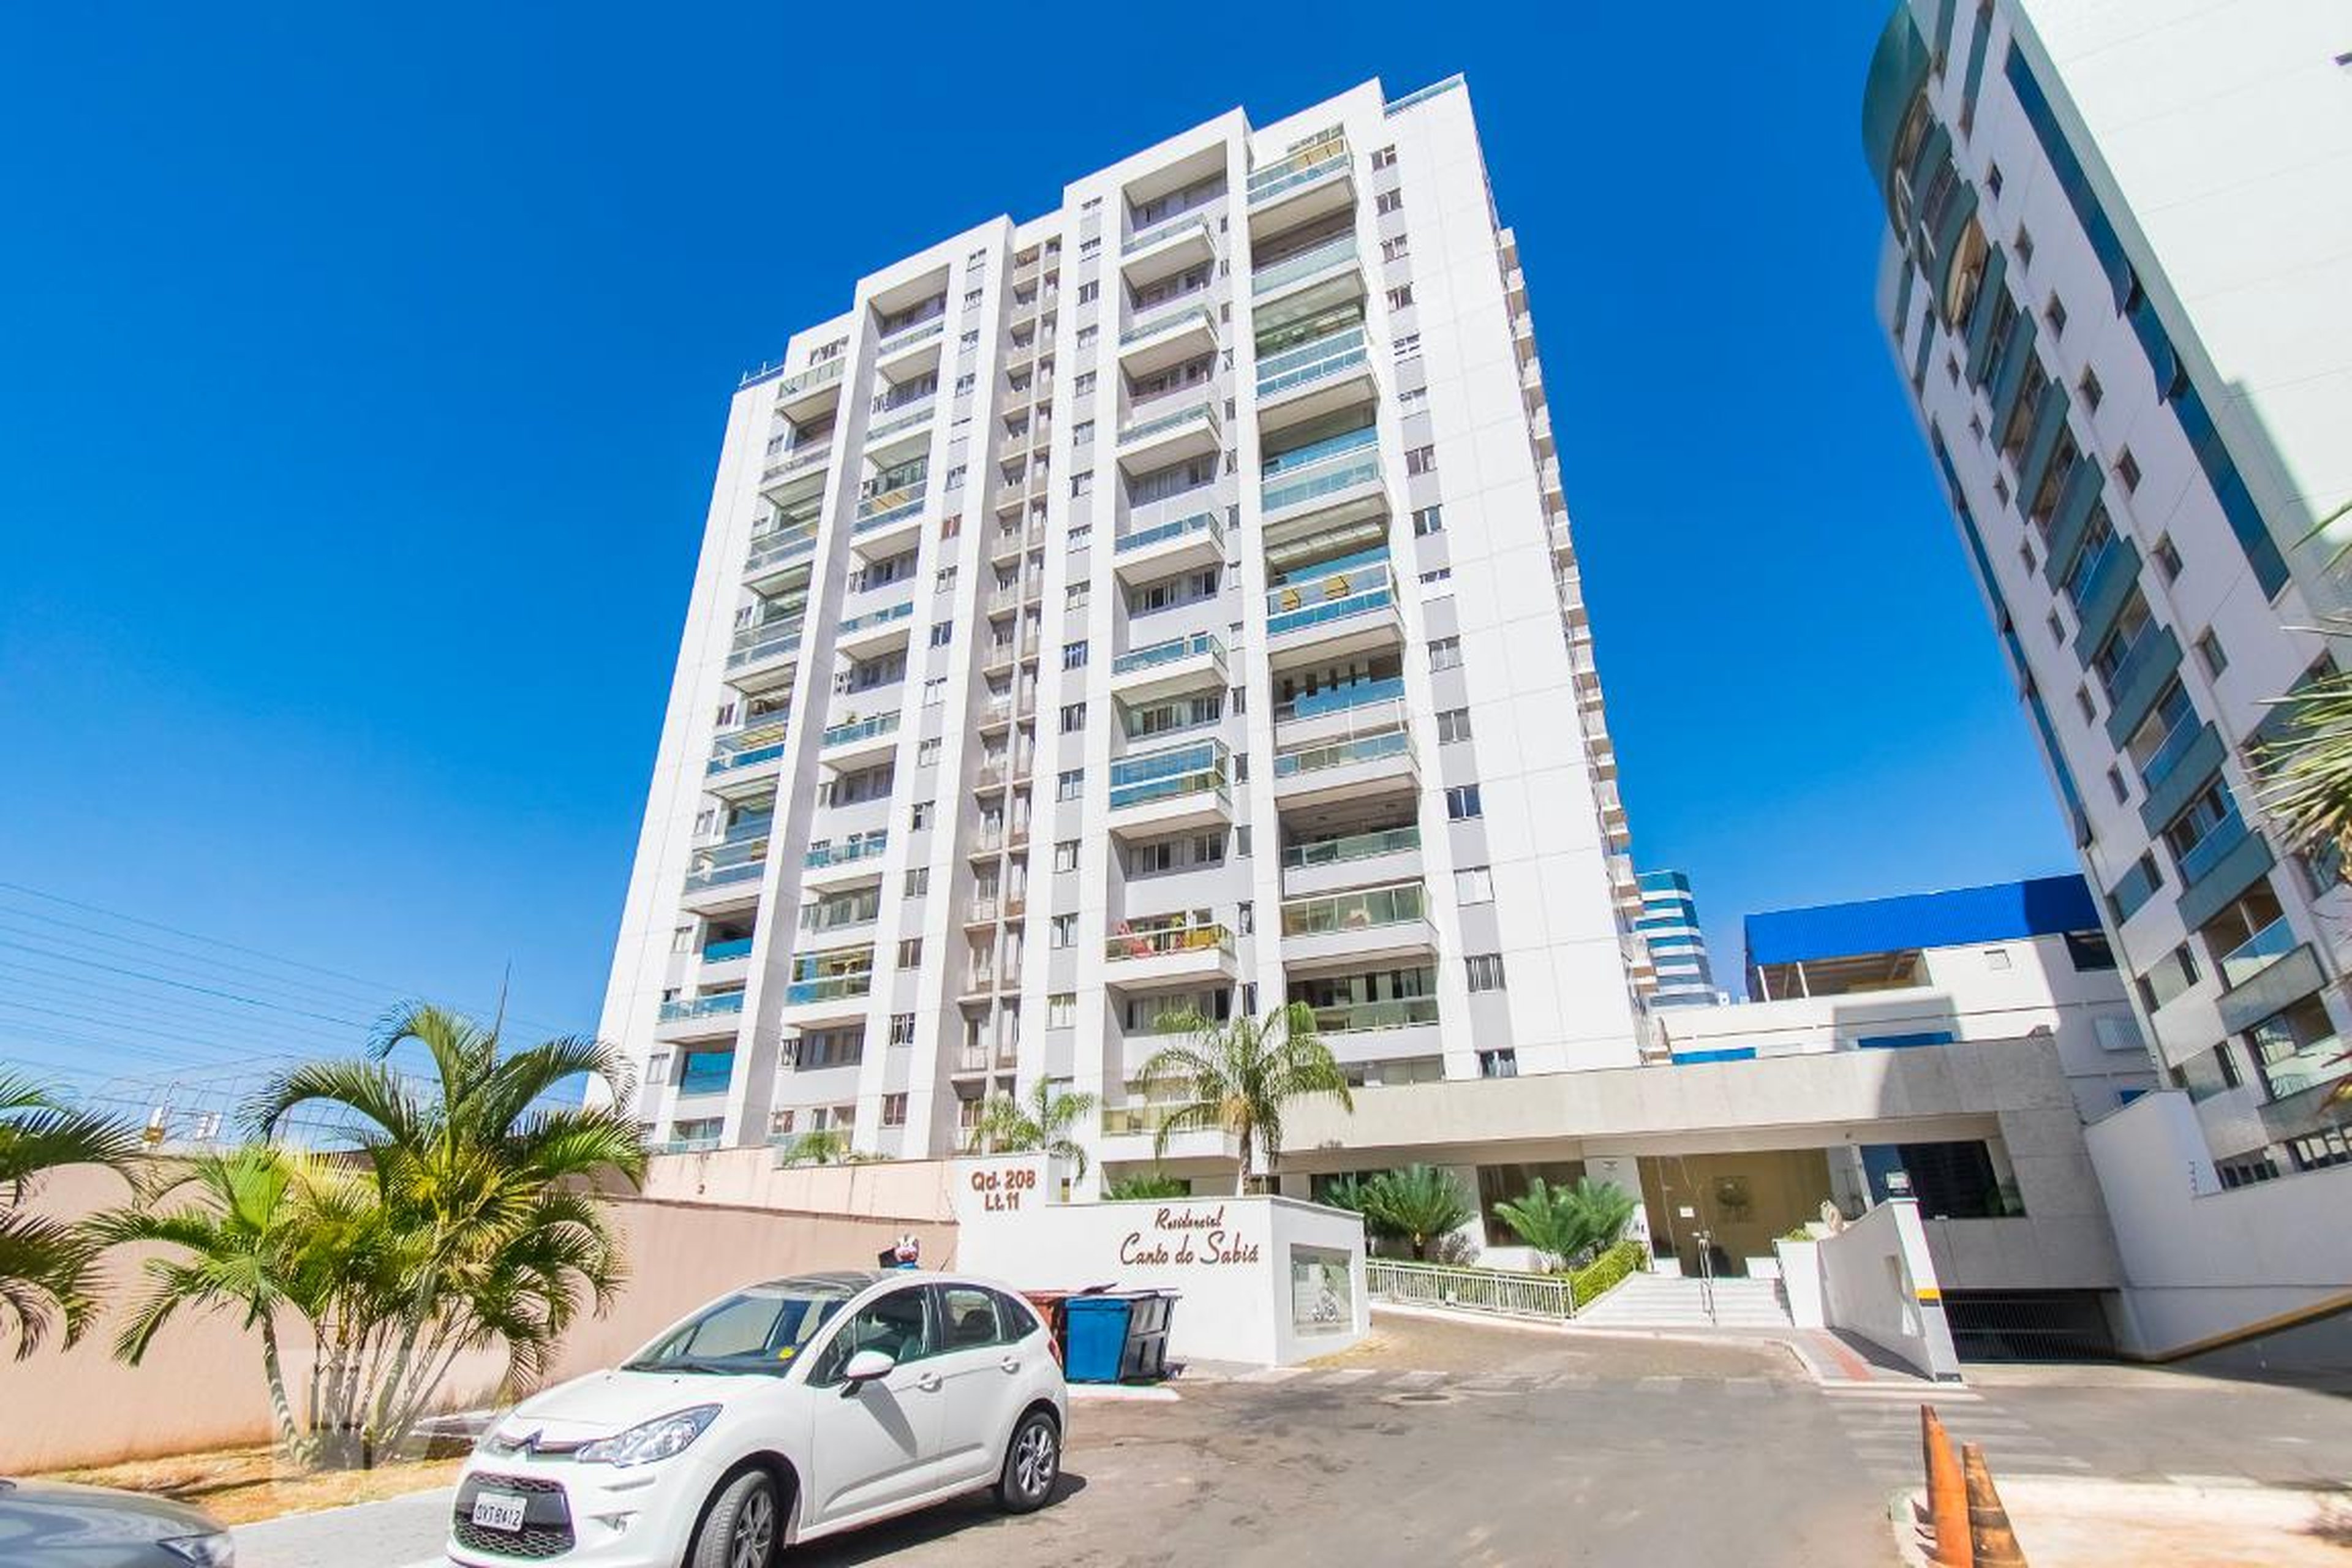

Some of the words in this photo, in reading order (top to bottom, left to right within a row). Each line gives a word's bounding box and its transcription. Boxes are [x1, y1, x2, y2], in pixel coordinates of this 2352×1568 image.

[971, 1171, 1001, 1192] Qd.
[1006, 1169, 1036, 1189] 208
[1155, 1205, 1224, 1230] Residencial
[1120, 1232, 1169, 1265] Canto
[1175, 1234, 1194, 1264] do
[1200, 1231, 1258, 1264] Sabiá
